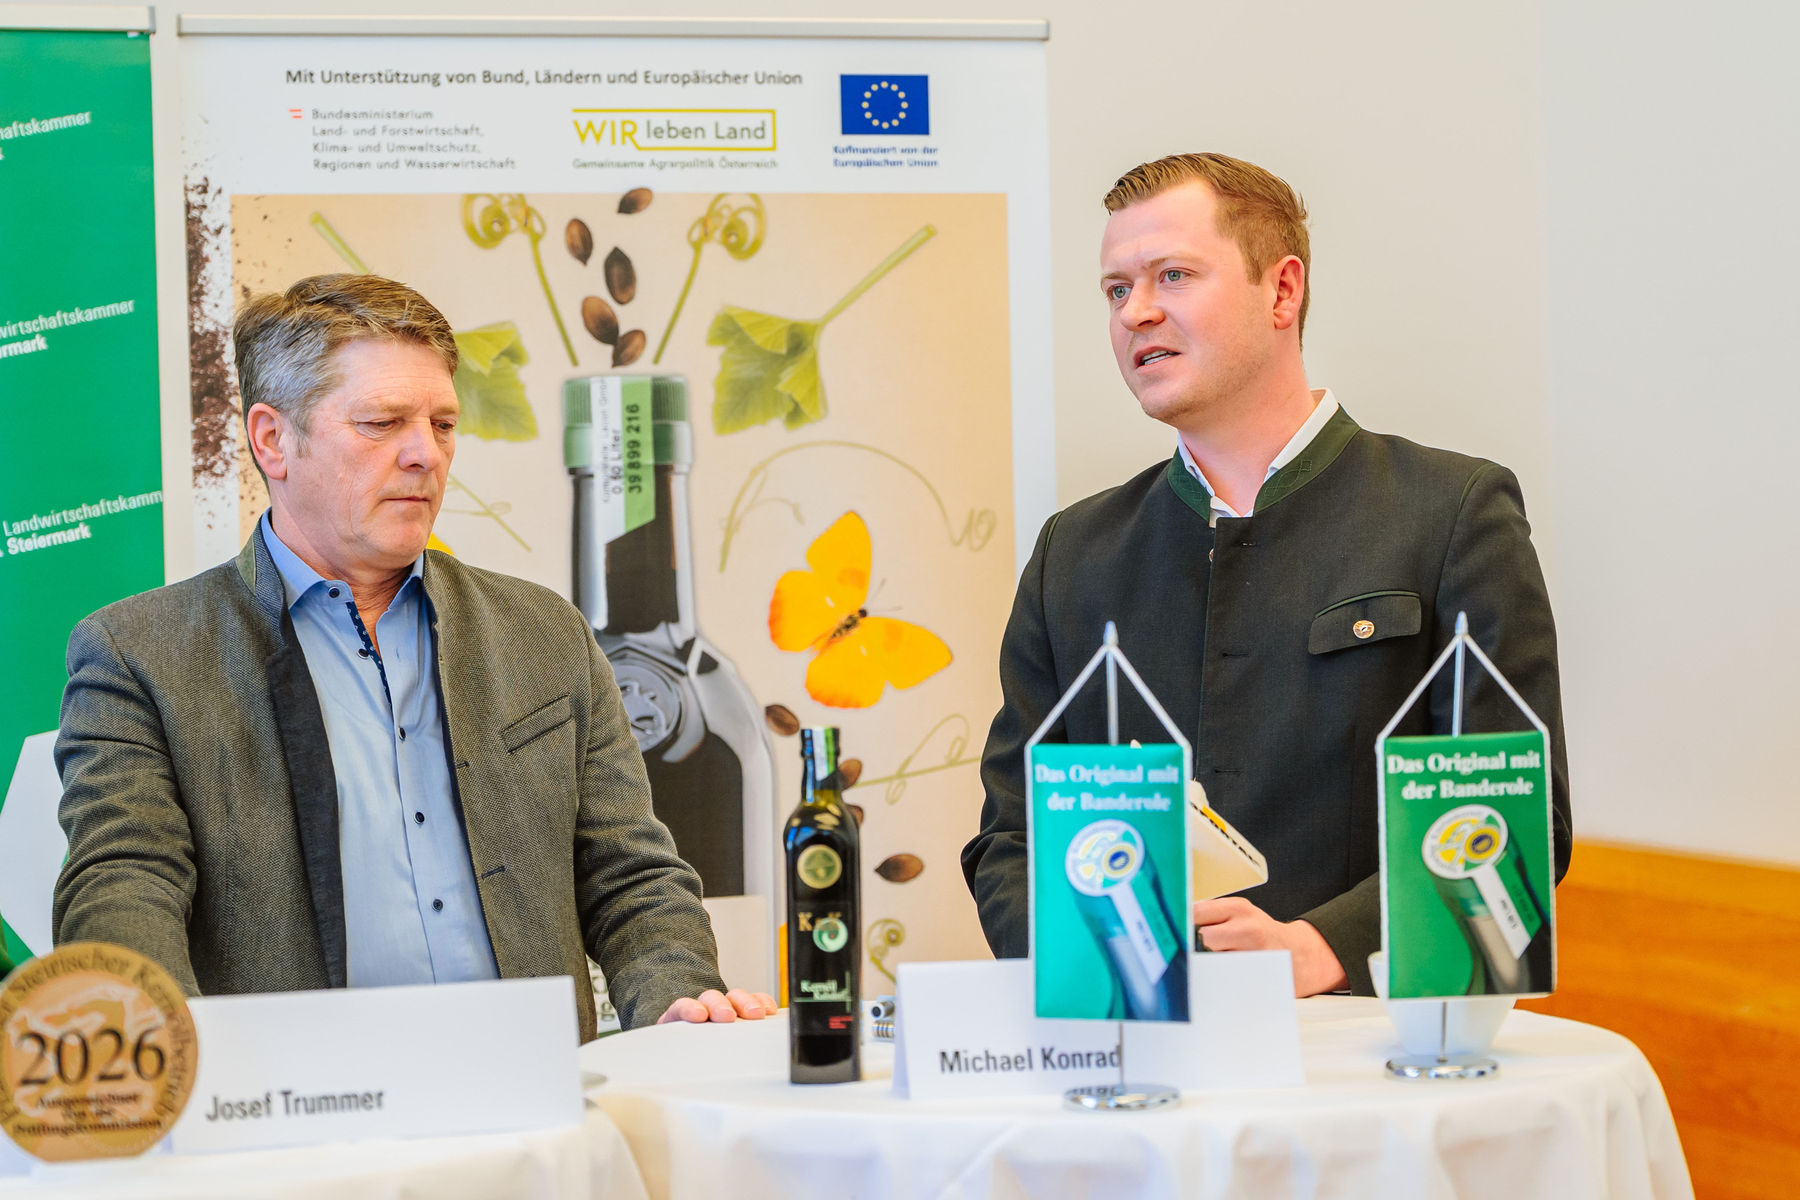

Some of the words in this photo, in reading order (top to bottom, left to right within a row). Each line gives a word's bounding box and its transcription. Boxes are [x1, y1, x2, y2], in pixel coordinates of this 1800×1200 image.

[286, 70, 315, 84] Mit
[321, 69, 441, 87] Unterstützung
[446, 73, 476, 84] von
[482, 70, 529, 86] Bund,
[535, 70, 600, 84] Ländern
[607, 70, 637, 84] und
[645, 70, 749, 87] Europäischer
[755, 71, 802, 84] Union
[312, 109, 434, 120] Bundesministerium
[353, 125, 376, 136] und
[573, 120, 638, 145] WIR
[647, 120, 706, 139] leben
[715, 121, 766, 139] Land
[358, 142, 381, 153] und
[313, 159, 371, 171] Regionen
[376, 159, 400, 169] und
[404, 159, 516, 170] Wasserwirtschaft
[572, 158, 645, 169] Gemeinsame
[649, 158, 714, 170] Agrarpolitik
[0, 334, 48, 359] rmark
[626, 404, 640, 434] 216
[627, 440, 641, 470] 899
[628, 475, 642, 494] 39
[7, 522, 92, 555] Steiermark
[1034, 763, 1066, 783] Das
[1068, 763, 1143, 786] Original
[1147, 764, 1179, 784] mit
[1387, 755, 1424, 775] Das
[1426, 750, 1506, 776] Original
[1510, 750, 1541, 769] mit
[1402, 780, 1436, 800] der
[1440, 776, 1534, 799] Banderole
[1047, 791, 1076, 811] der
[1080, 791, 1172, 812] Banderole
[17, 1028, 165, 1086] 2026
[939, 1048, 1034, 1074] Michael
[1041, 1045, 1122, 1070] Konrad
[206, 1092, 273, 1122] Josef
[279, 1089, 385, 1116] Trummer
